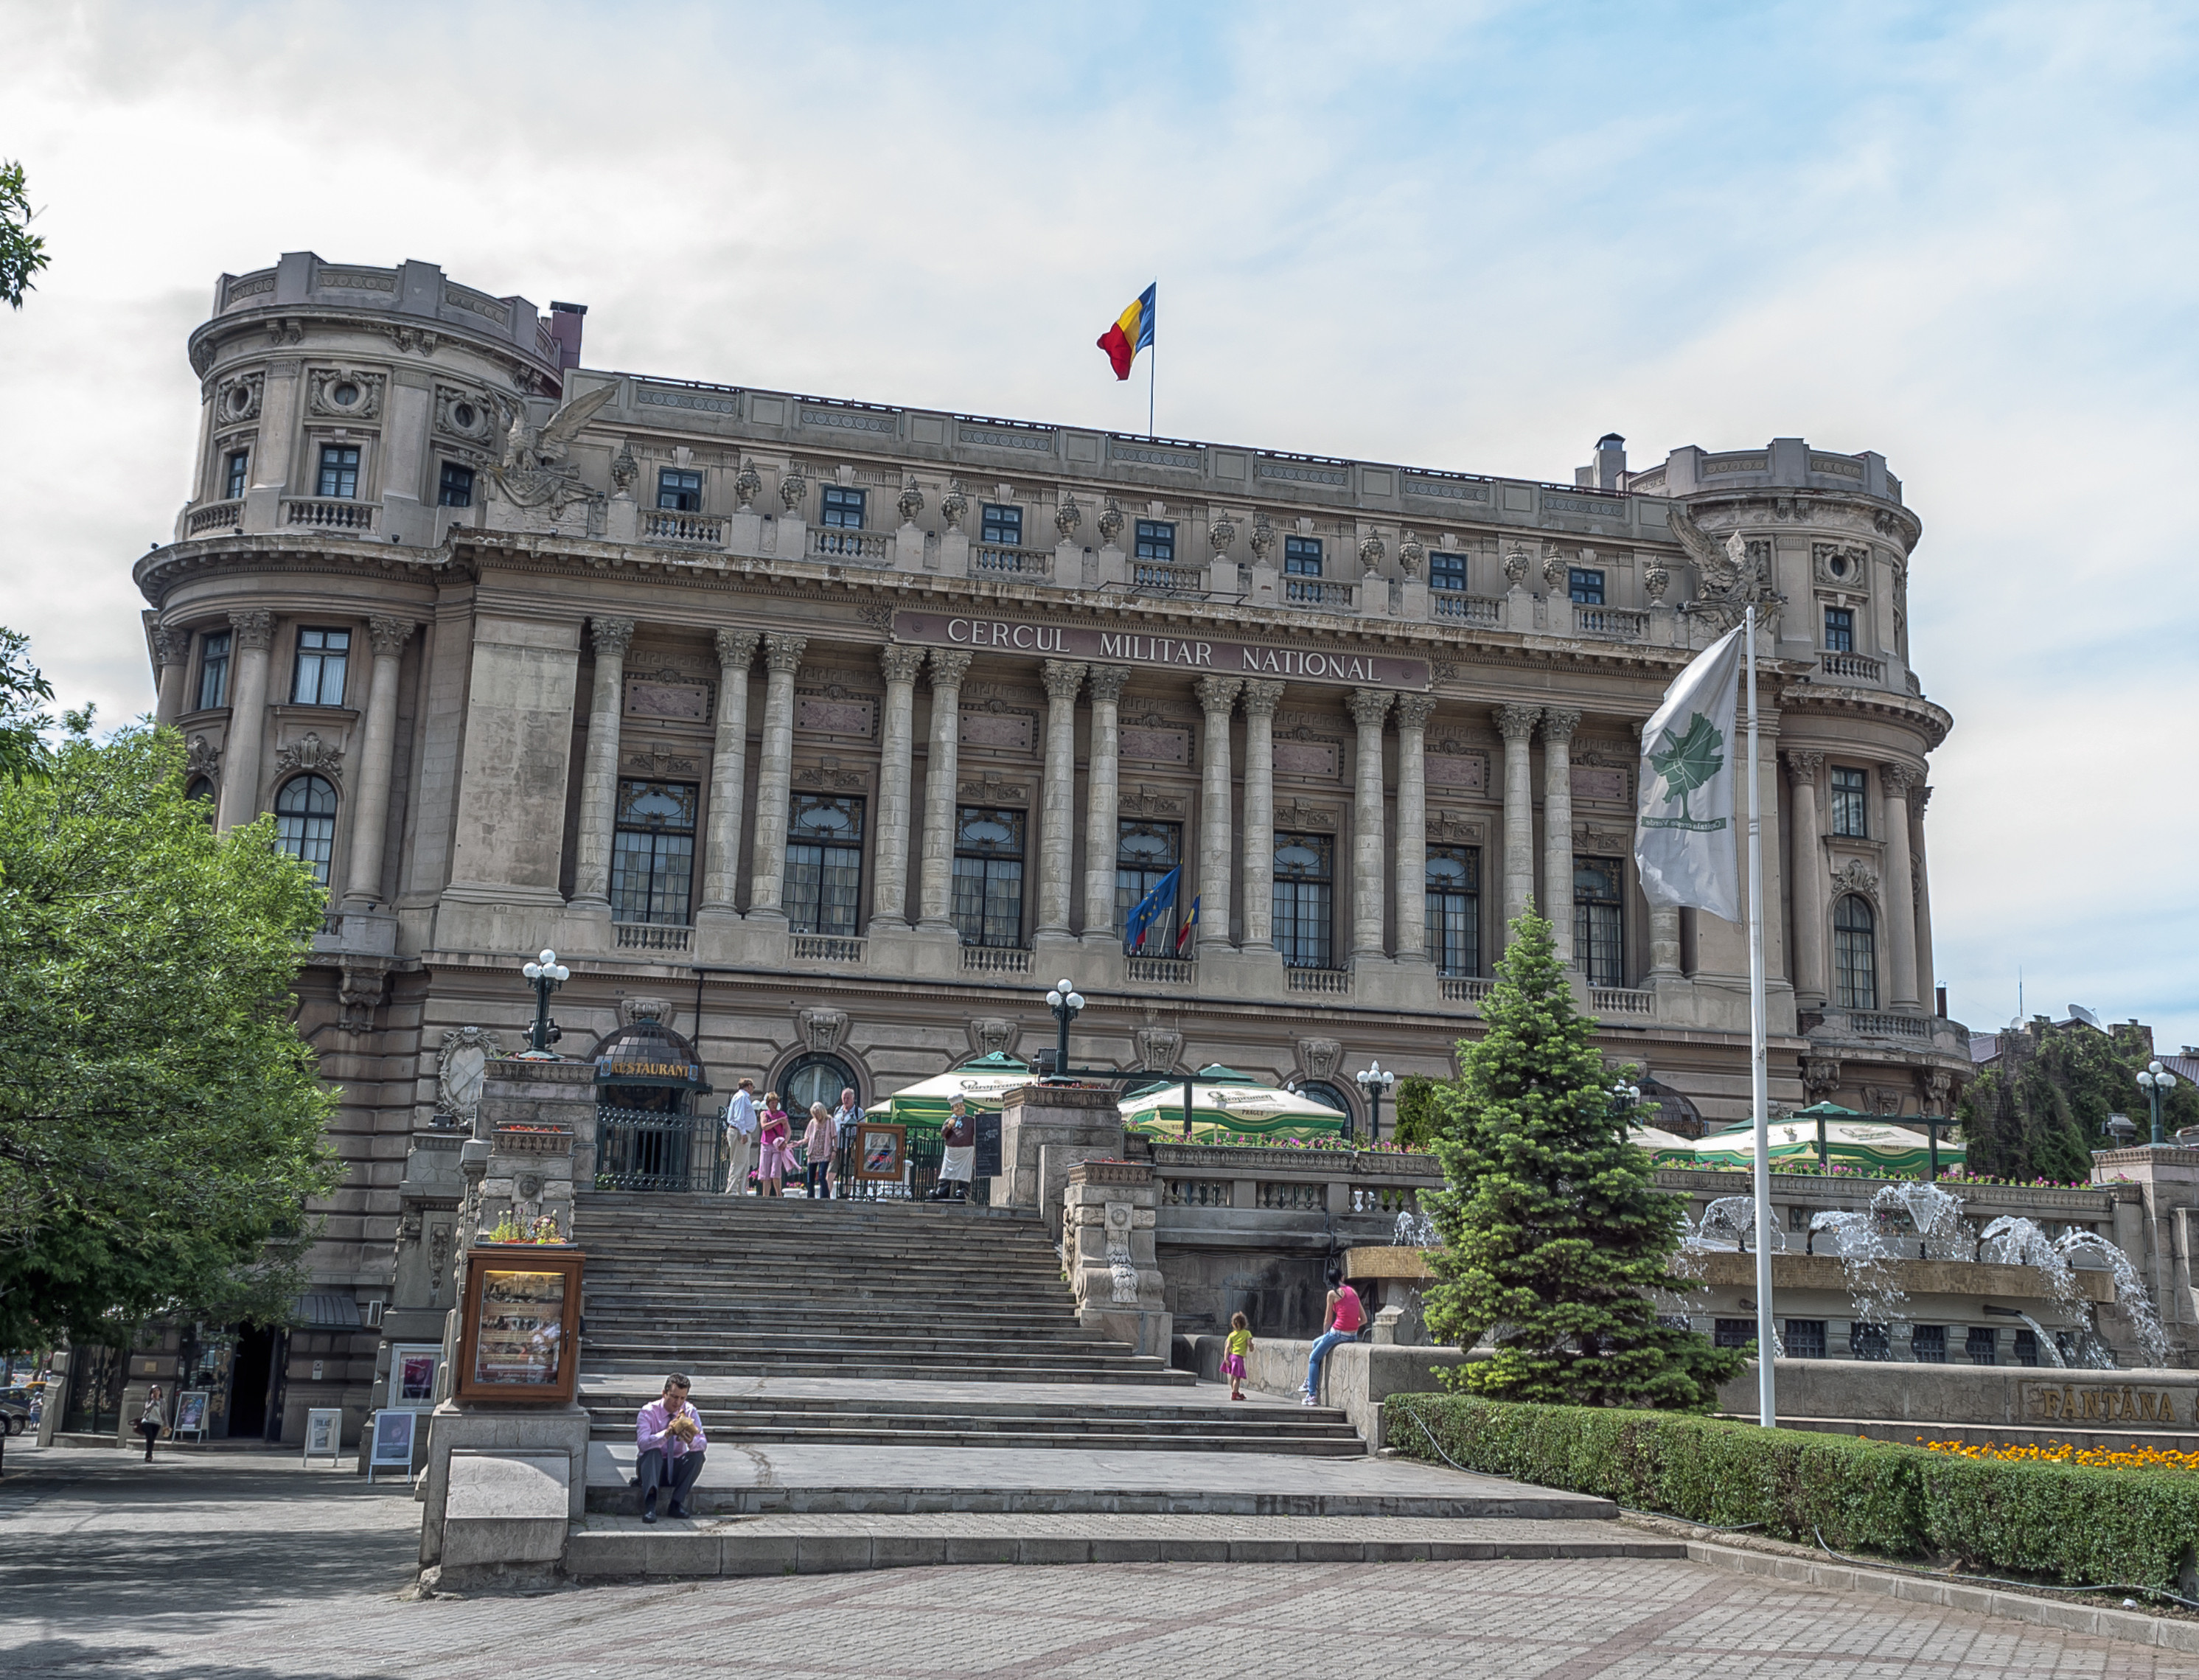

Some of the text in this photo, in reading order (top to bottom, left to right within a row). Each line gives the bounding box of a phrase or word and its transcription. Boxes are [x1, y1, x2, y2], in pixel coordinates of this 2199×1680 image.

[947, 618, 1381, 682] CERCUL MILITAR NATIONAL
[610, 1062, 689, 1076] RESTAURANT
